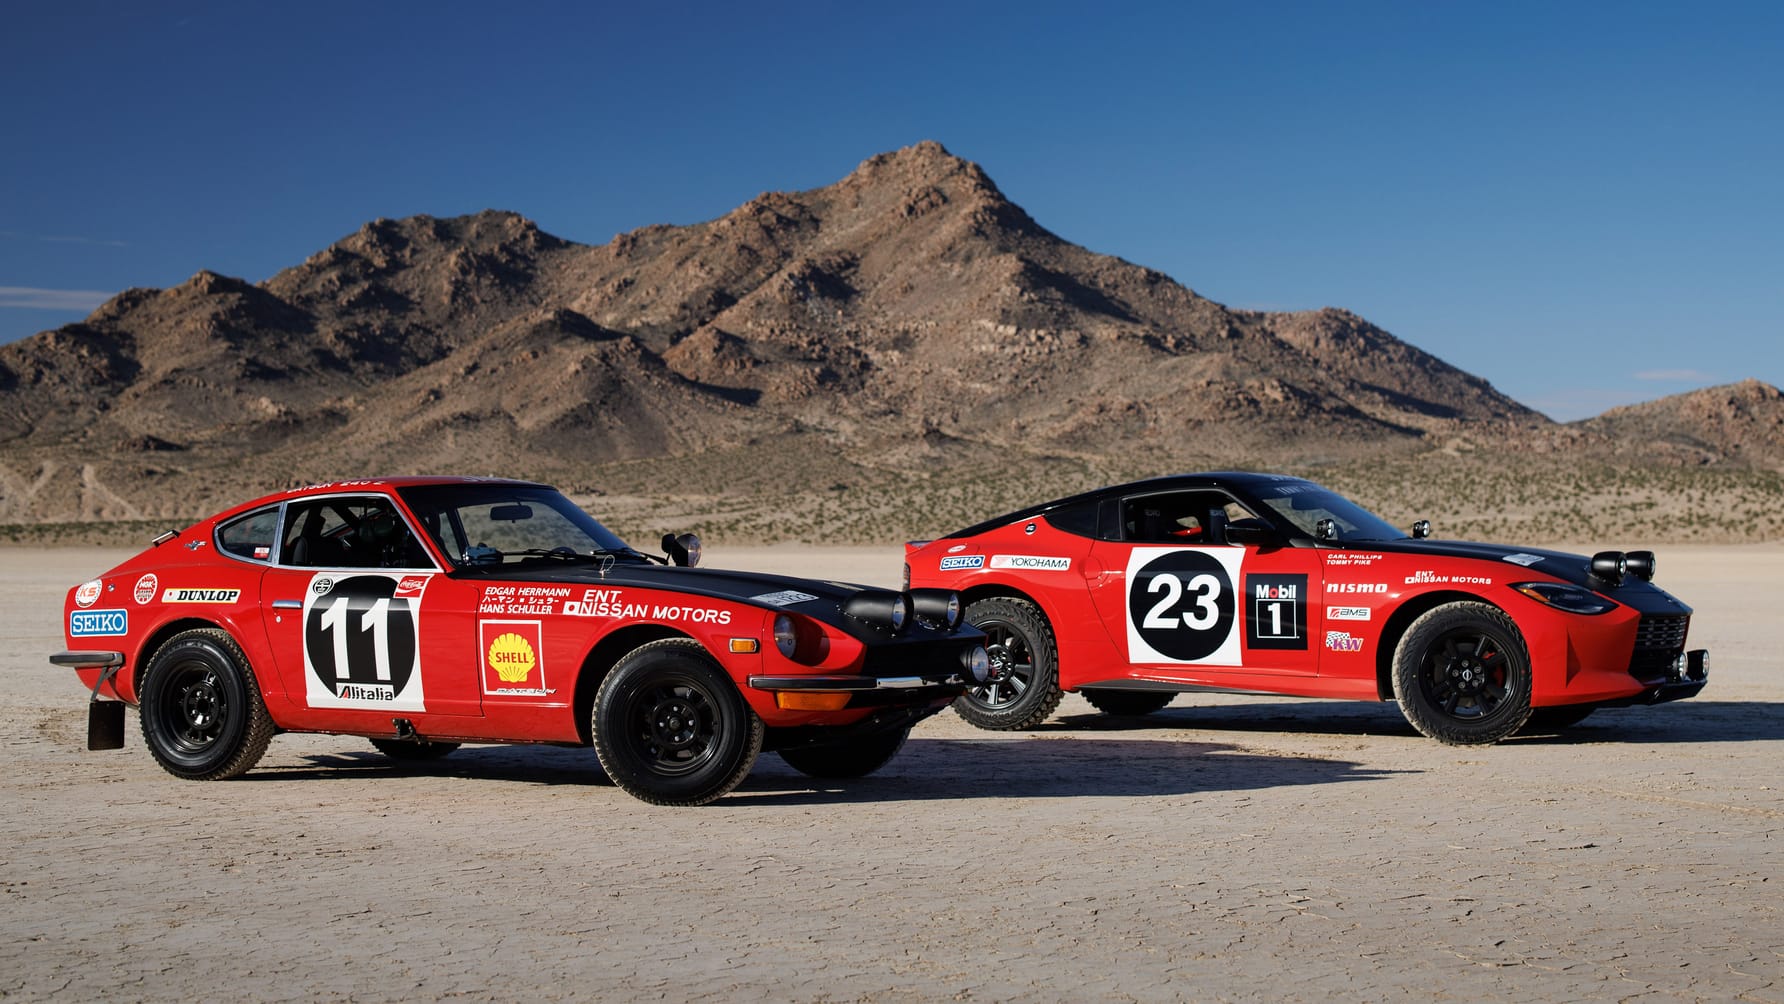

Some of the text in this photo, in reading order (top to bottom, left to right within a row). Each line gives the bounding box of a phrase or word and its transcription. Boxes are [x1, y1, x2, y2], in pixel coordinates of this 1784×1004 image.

[942, 556, 982, 568] SEIKO
[1011, 557, 1068, 568] YOKOHAMA
[1414, 575, 1492, 585] NISSAN MOTORS
[80, 587, 97, 597] KS
[177, 590, 239, 601] DUNLOP
[485, 586, 571, 597] EDGAR HERRMANN
[583, 589, 622, 603] ENT.
[1255, 584, 1297, 599] Mobil
[1142, 573, 1221, 631] 23
[479, 604, 552, 615] HANS SCHULLER
[579, 601, 731, 625] NISSAN MOTORS
[72, 613, 125, 633] SEIKO
[1267, 602, 1281, 635] 1
[321, 597, 392, 680] 11
[1331, 638, 1364, 652] KW
[495, 651, 529, 664] SHELL
[339, 686, 393, 701] Alitalia
